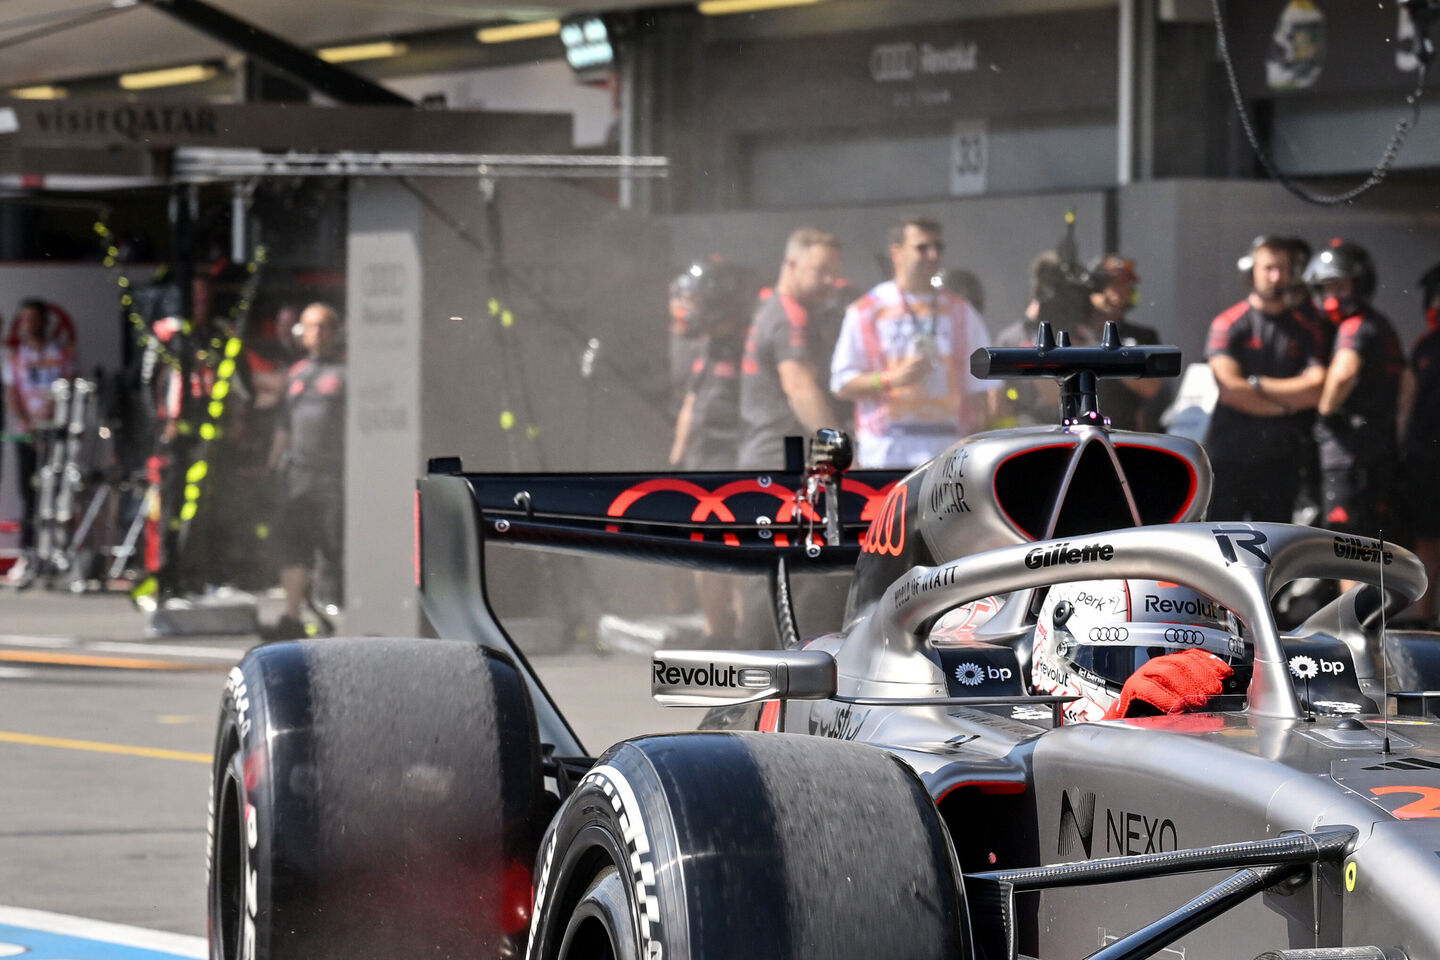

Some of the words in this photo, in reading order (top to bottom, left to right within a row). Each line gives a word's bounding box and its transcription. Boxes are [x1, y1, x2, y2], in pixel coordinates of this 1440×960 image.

[1024, 541, 1114, 569] Gillette
[1333, 535, 1395, 566] Gillette
[1144, 594, 1218, 619] Revolut
[653, 660, 737, 687] Revolut
[987, 665, 1012, 682] bp
[1320, 658, 1345, 676] bp
[1106, 808, 1178, 857] NEXO
